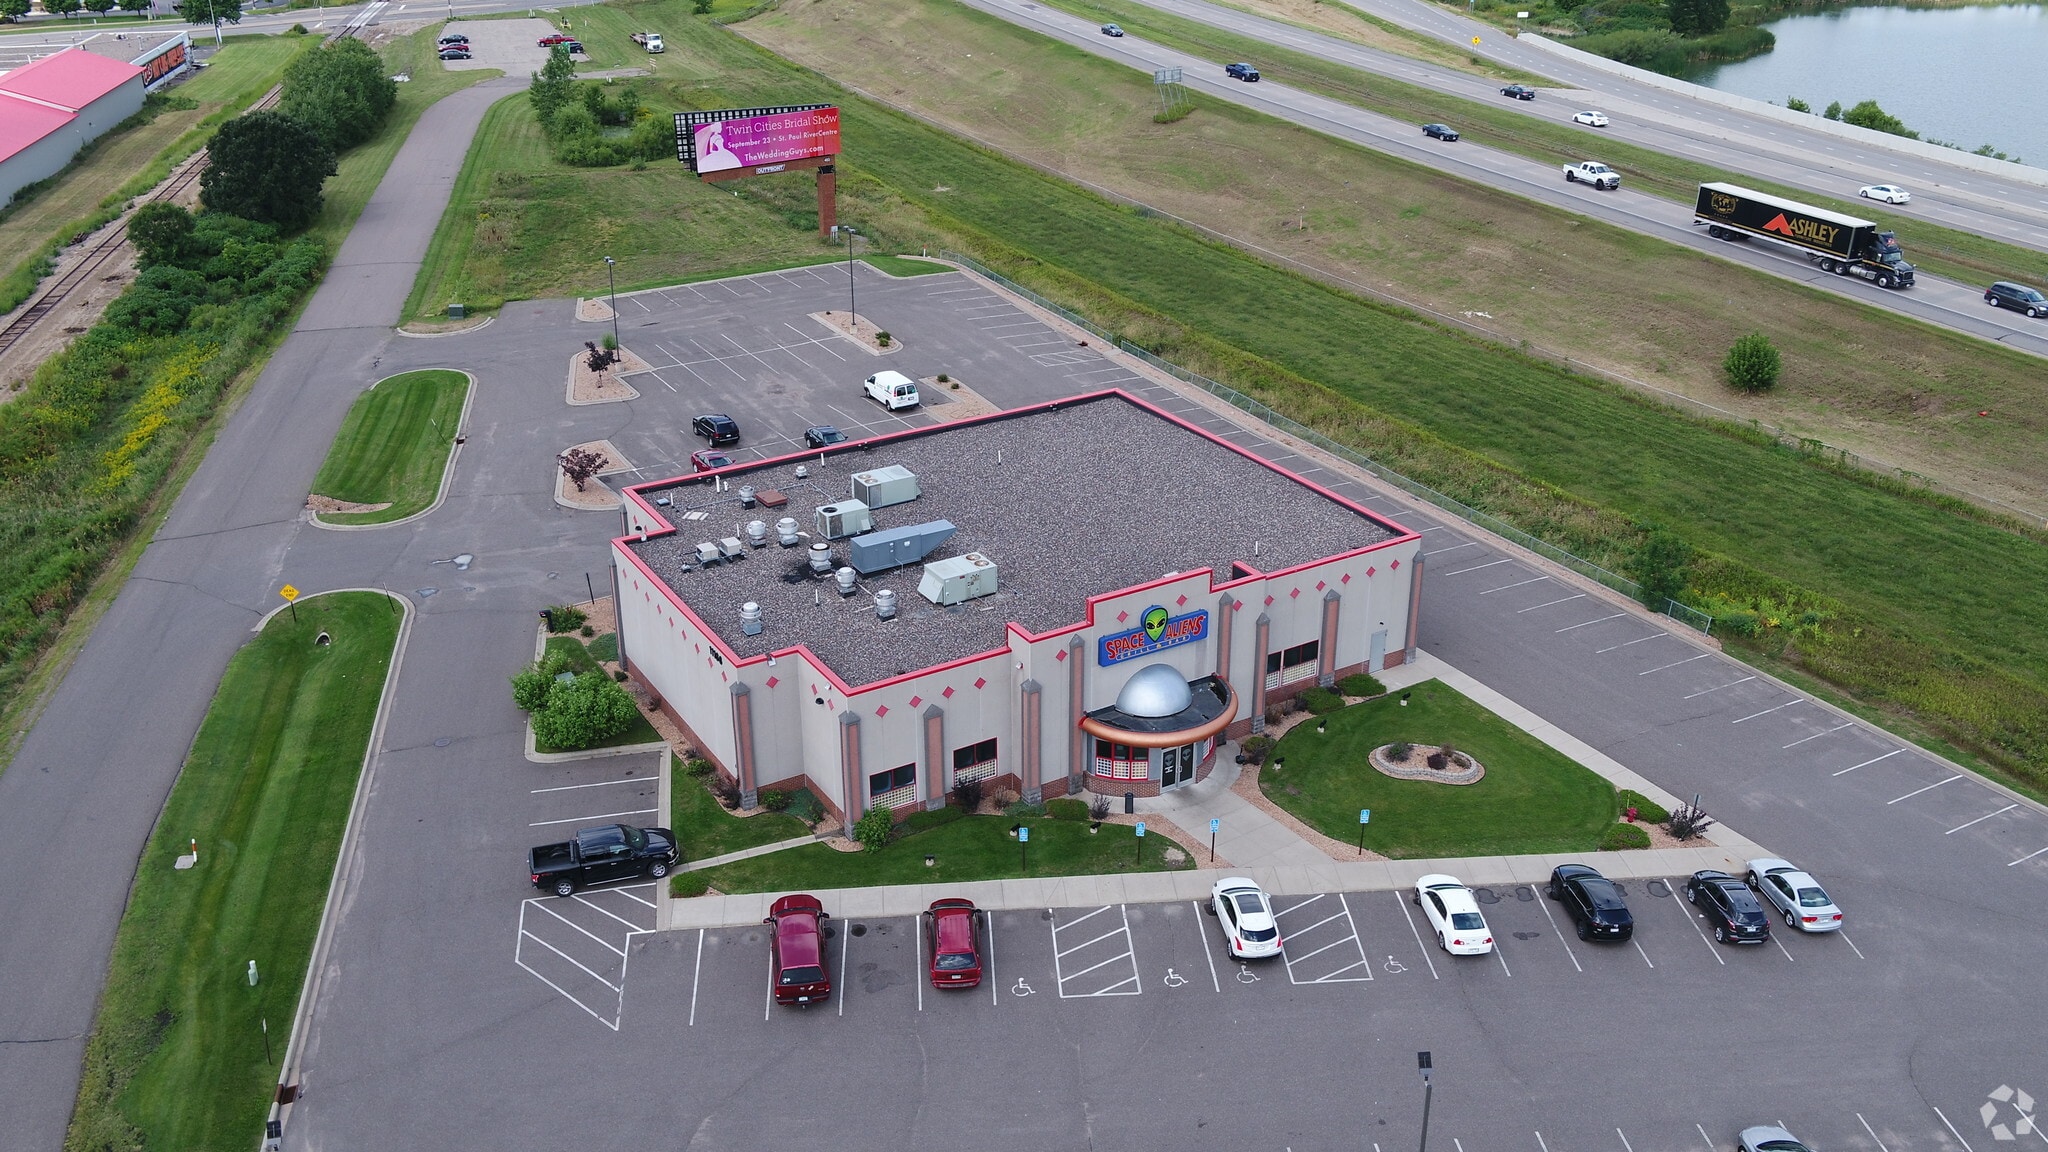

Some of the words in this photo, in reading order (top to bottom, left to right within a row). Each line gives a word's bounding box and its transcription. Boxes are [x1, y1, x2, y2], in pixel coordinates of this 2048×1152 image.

[726, 124, 753, 136] Twin
[755, 120, 782, 133] Cities
[784, 116, 811, 129] Bridal
[812, 113, 838, 125] Show
[727, 138, 761, 150] September
[762, 136, 771, 145] 23
[778, 134, 787, 142] St.
[788, 132, 802, 141] Paul
[803, 129, 838, 140] RiverCentre
[744, 145, 824, 163] TheWeddingGuys.com
[1788, 218, 1839, 243] ASHLEY
[1105, 632, 1144, 659] SPACE
[1165, 615, 1204, 639] ALIENS
